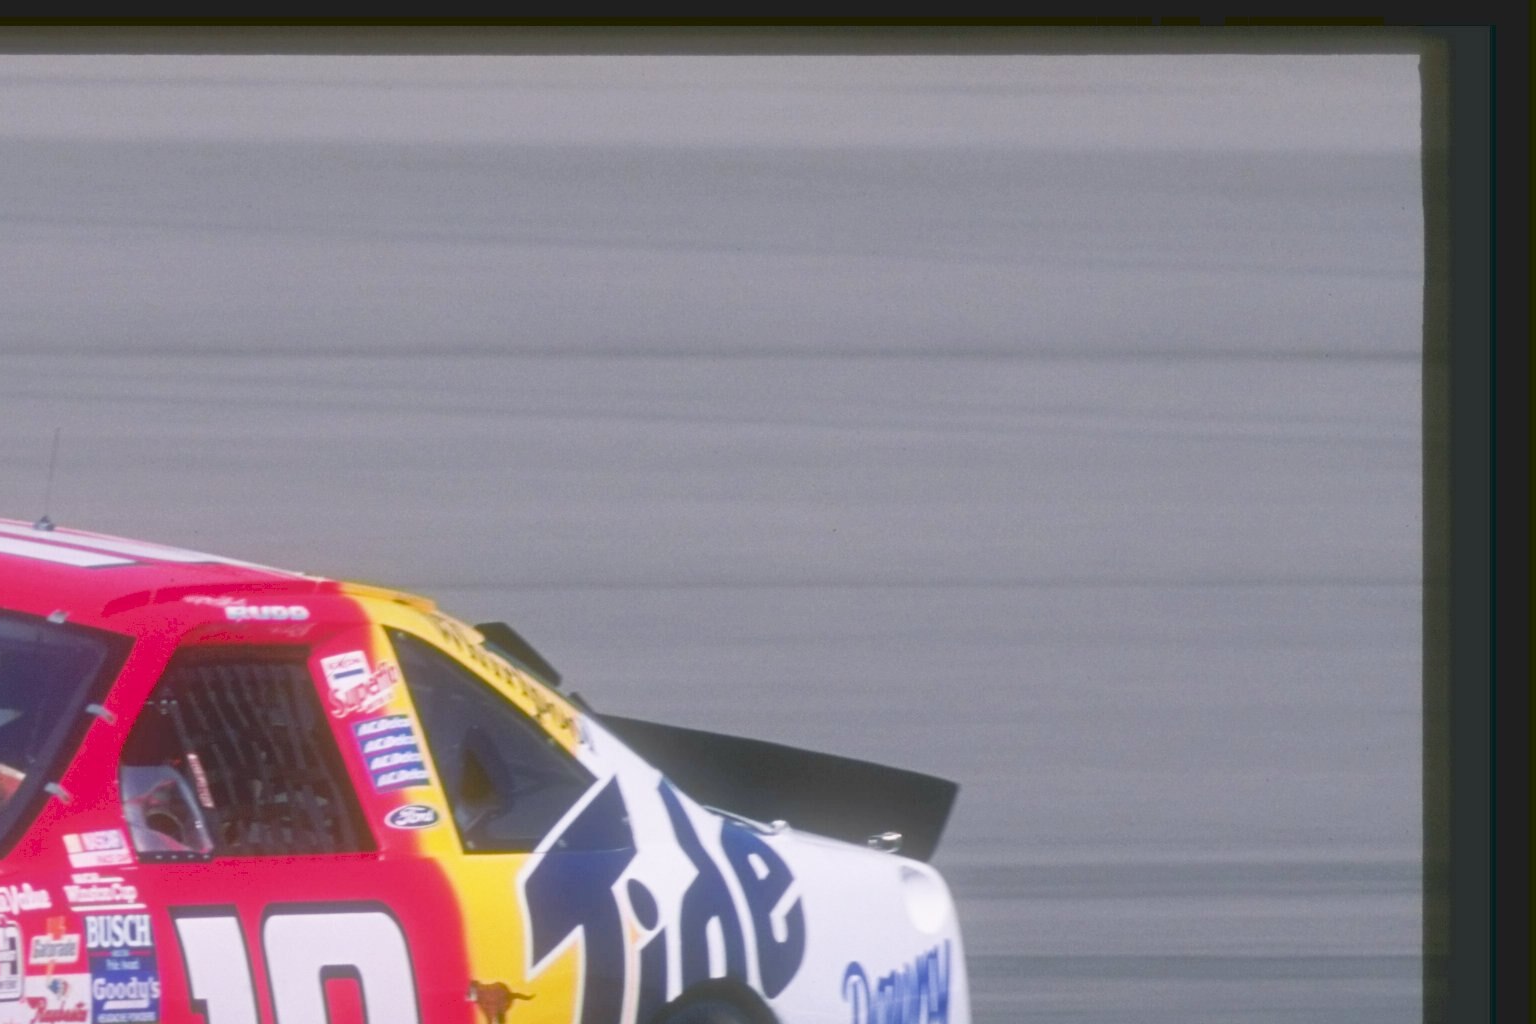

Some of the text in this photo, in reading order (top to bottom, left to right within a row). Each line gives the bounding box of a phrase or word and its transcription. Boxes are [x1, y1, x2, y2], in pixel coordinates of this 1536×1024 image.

[225, 605, 310, 621] RUDD
[86, 915, 152, 948] BUSCH
[93, 976, 160, 1001] Goody's
